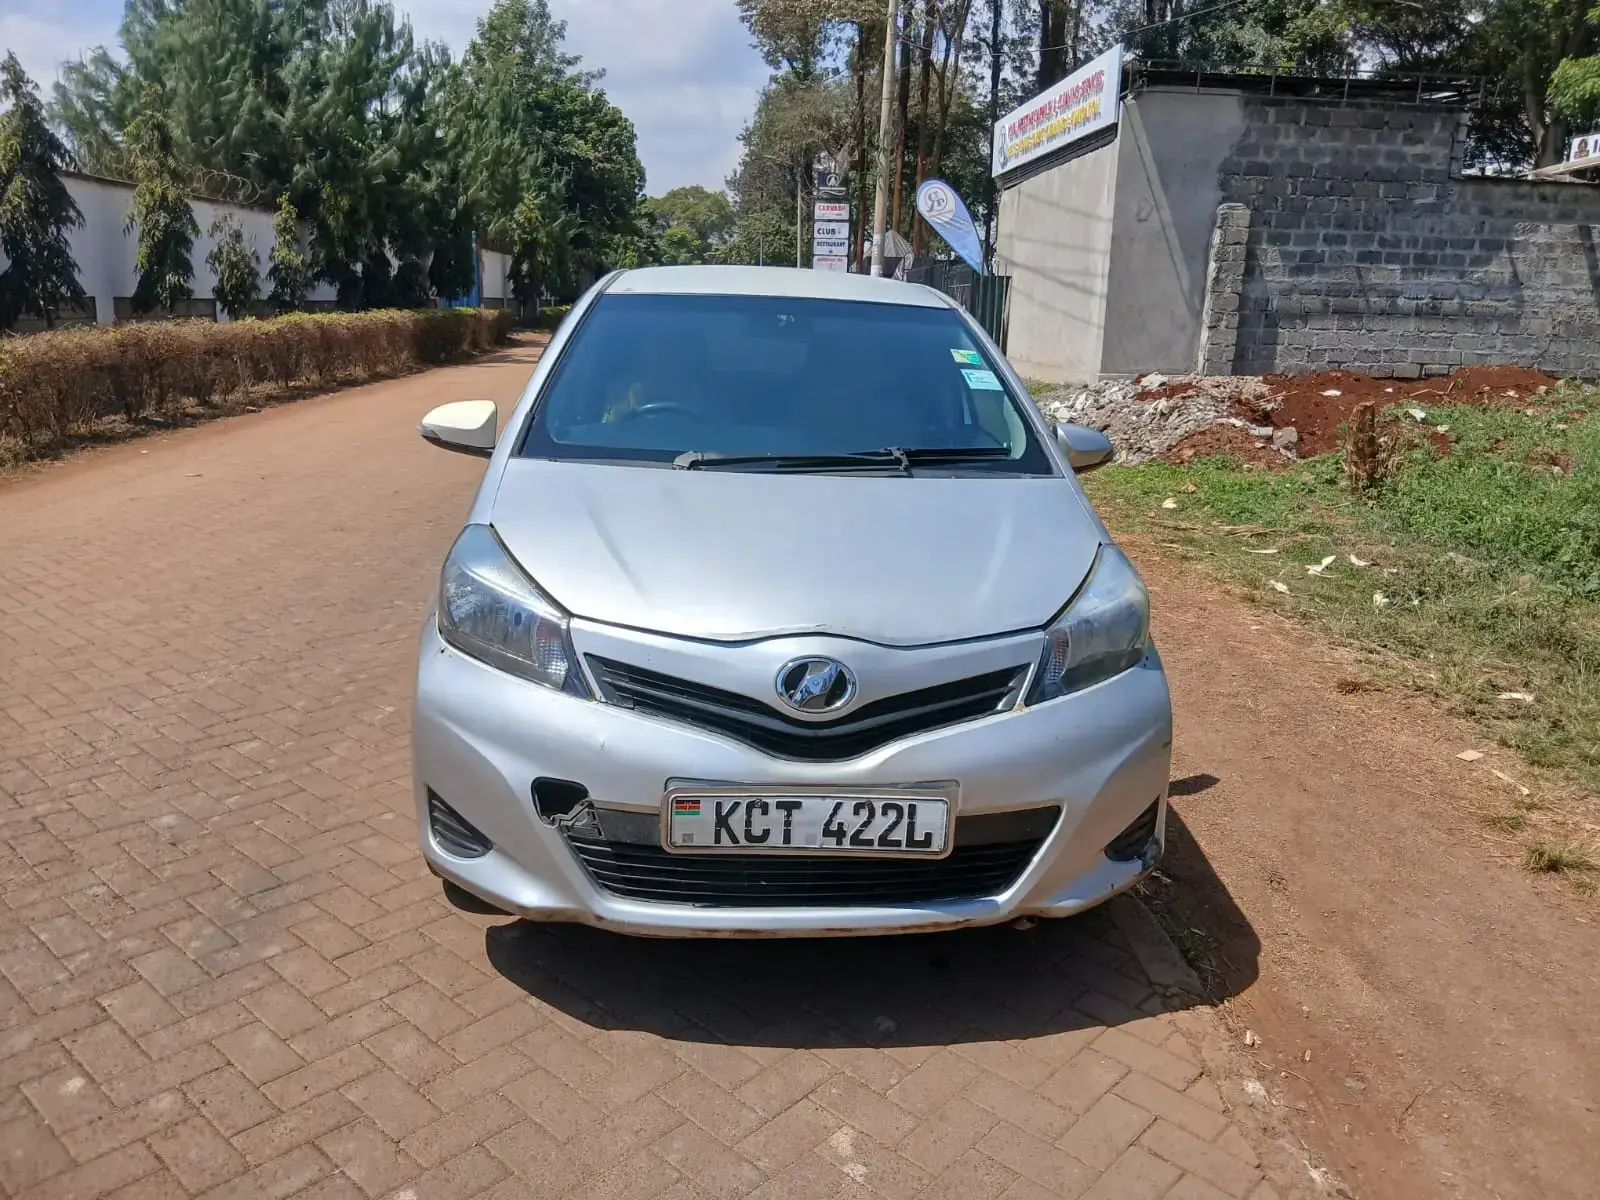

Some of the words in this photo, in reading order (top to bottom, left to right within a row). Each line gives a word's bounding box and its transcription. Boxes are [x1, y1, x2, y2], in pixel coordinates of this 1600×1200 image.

[817, 227, 836, 236] CLUB
[713, 798, 803, 845] KCT
[821, 800, 933, 849] 422L
